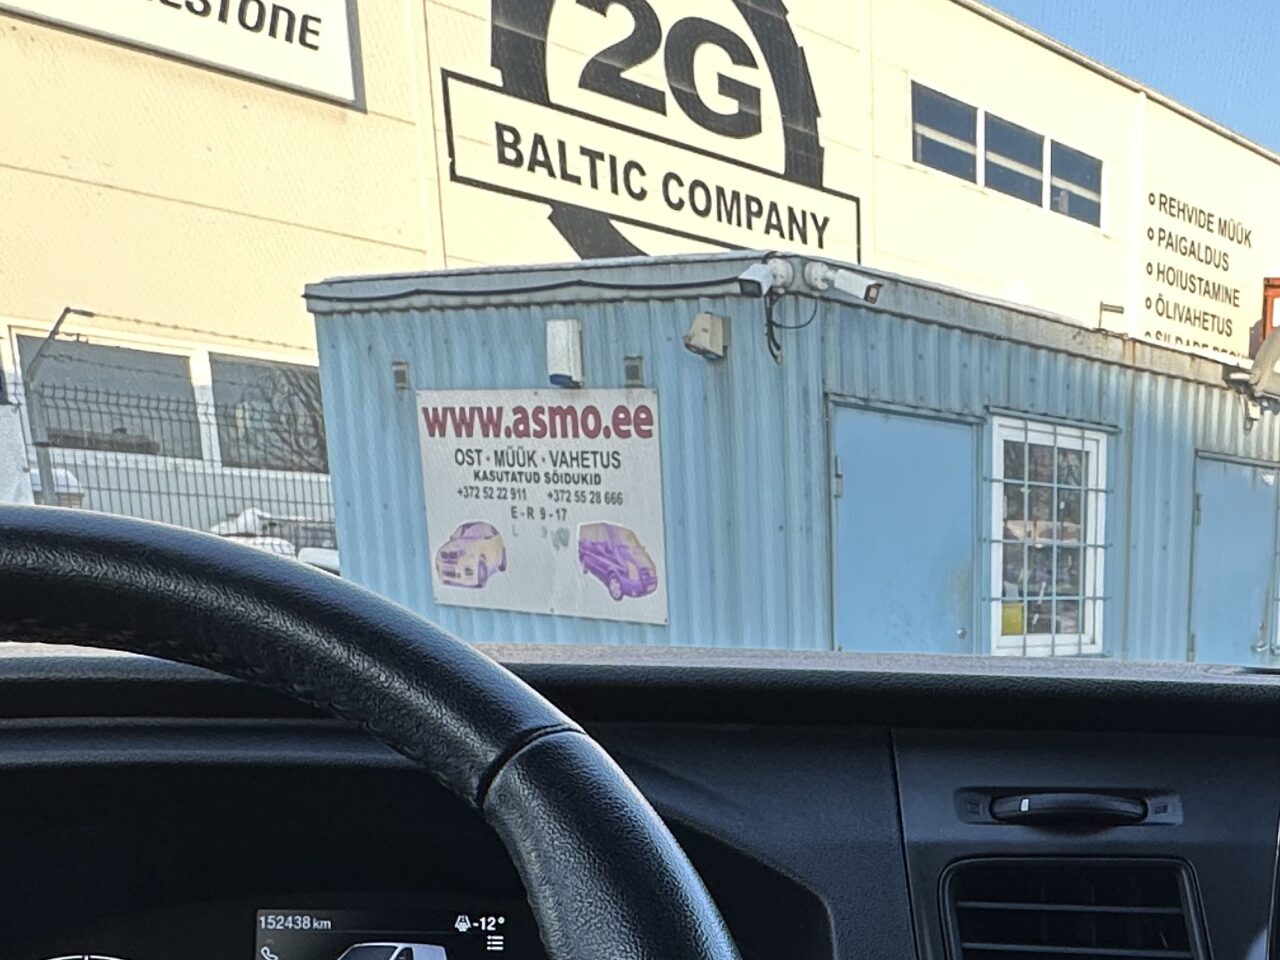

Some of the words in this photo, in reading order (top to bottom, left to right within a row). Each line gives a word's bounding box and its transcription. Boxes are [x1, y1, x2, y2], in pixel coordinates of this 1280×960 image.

[495, 121, 648, 201] BALTIC
[662, 171, 830, 250] COMPANY
[1158, 193, 1215, 233] REHVIDE
[1217, 217, 1253, 249] MÜÜK
[1157, 227, 1230, 272] PAIGALDUS
[1156, 263, 1241, 308] HOIUSTAMINE
[422, 404, 654, 440] www.asmo.ee
[454, 448, 483, 466] OST
[494, 446, 538, 468] MÜÜK
[550, 450, 622, 469] VAHETUS
[474, 469, 541, 484] KASUTATUD
[457, 486, 480, 499] +372
[483, 487, 494, 499] 52
[496, 487, 508, 500] 22
[510, 488, 527, 501] 911
[547, 490, 572, 503] +372
[574, 490, 587, 503] 55
[604, 491, 624, 506] 666
[472, 916, 505, 931] -12°
